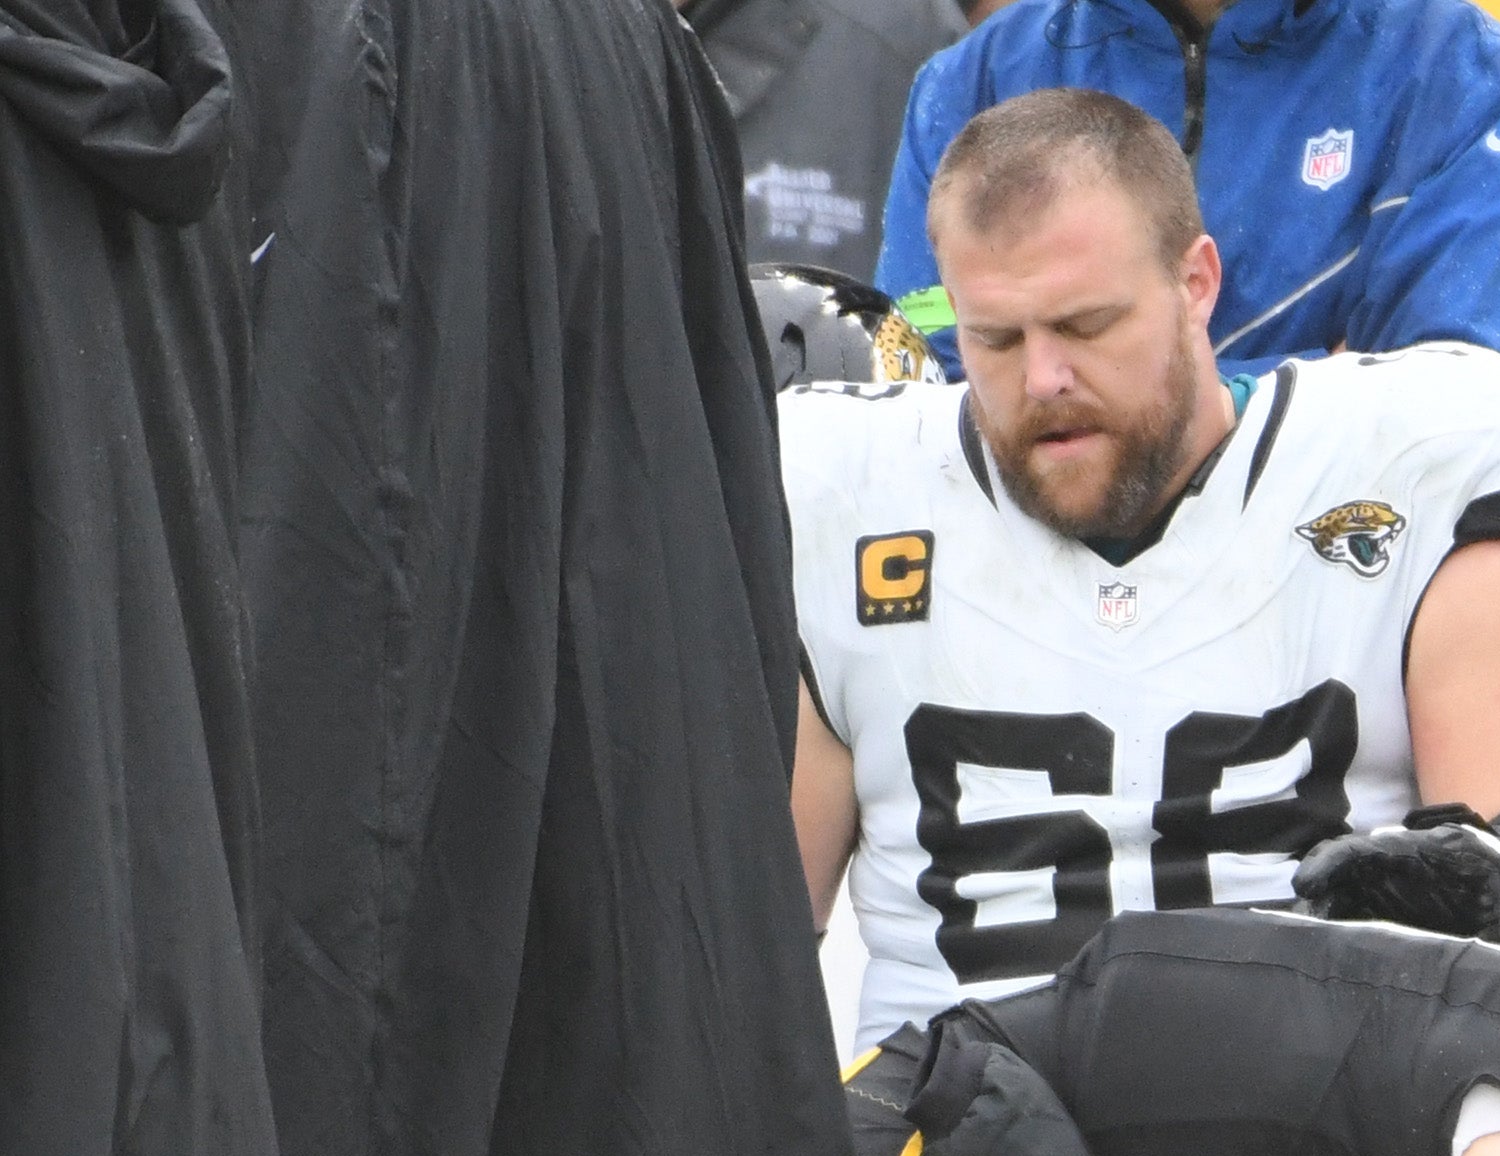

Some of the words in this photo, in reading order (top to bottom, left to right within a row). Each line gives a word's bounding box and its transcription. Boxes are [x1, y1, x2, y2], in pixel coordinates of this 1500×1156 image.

[1310, 155, 1343, 178] NFL
[861, 536, 927, 600] C
[1102, 599, 1133, 619] NFL
